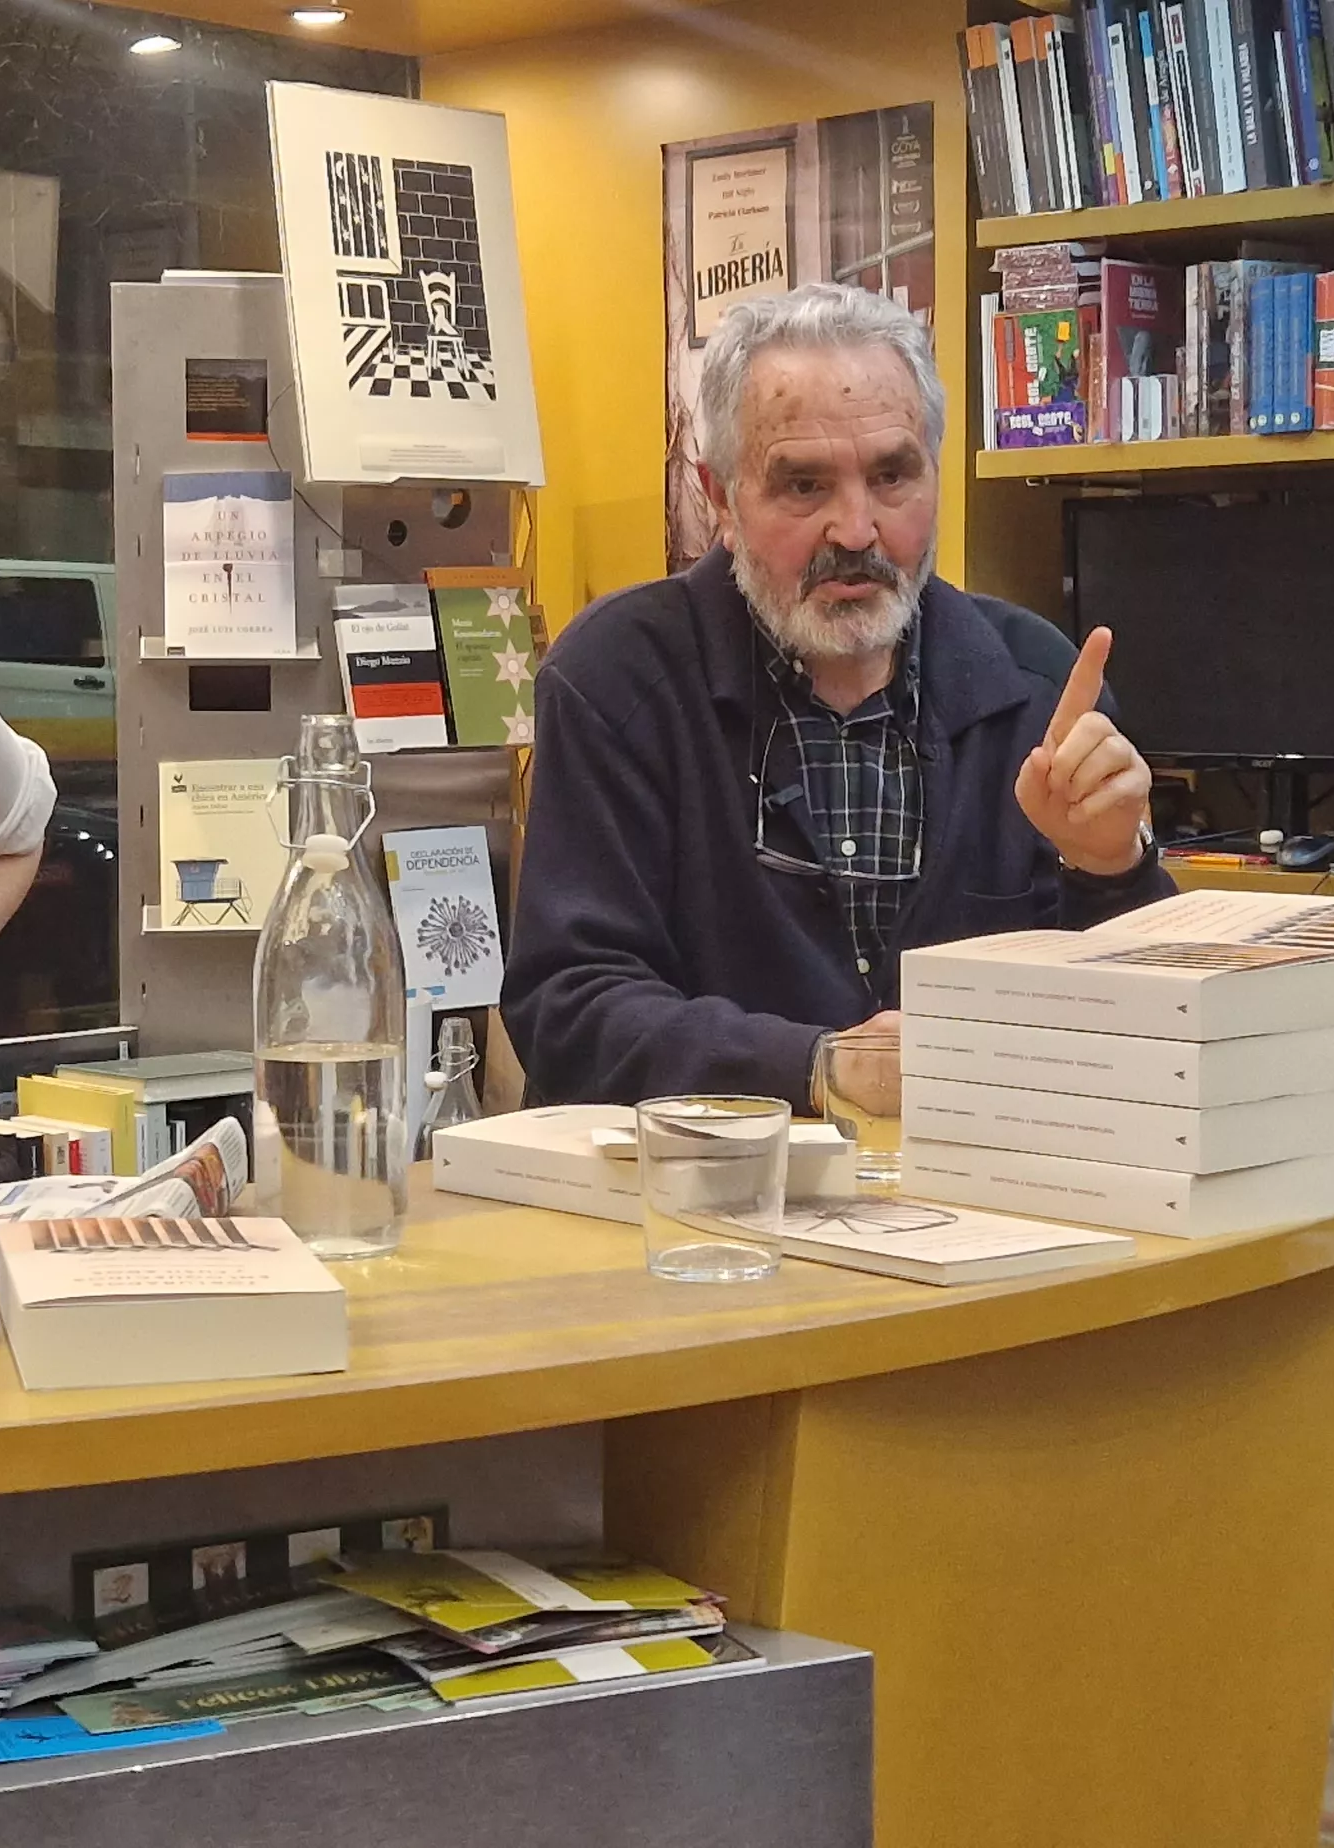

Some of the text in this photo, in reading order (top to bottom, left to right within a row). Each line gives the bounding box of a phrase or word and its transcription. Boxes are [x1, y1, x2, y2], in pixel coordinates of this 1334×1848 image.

[697, 242, 783, 300] LIBRERÍA
[218, 511, 239, 520] UN
[191, 531, 266, 541] ARPEGIO
[182, 551, 279, 561] DE LLUVIA
[203, 573, 255, 583] EN EL
[189, 593, 266, 603] CRISTAL
[356, 657, 380, 668] Diego
[411, 848, 464, 859] DECLARACIÓN
[406, 855, 480, 871] DEPENDENCIA
